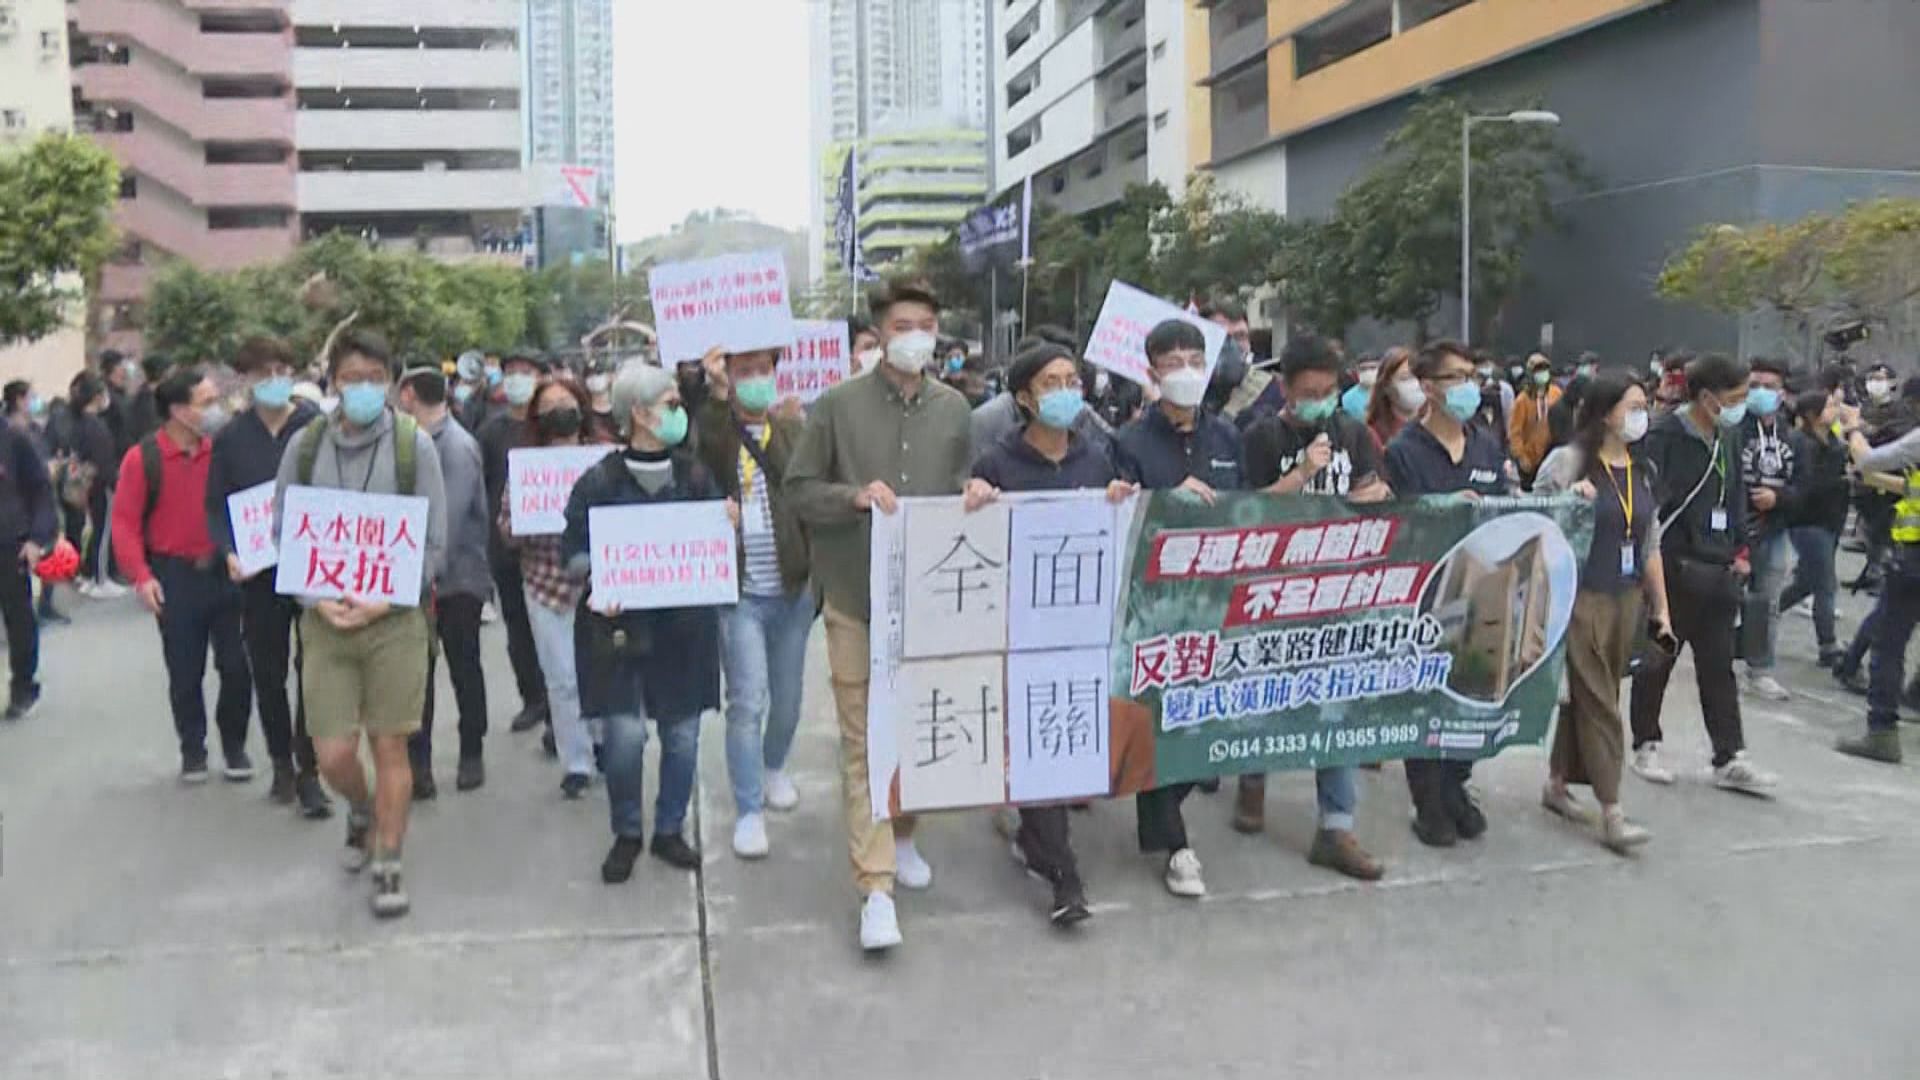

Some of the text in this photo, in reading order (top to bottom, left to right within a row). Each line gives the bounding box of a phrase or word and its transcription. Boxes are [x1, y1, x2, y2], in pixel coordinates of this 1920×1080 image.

[293, 507, 417, 550] 天水圍人
[305, 545, 395, 596] 反抗
[1159, 531, 1280, 575] 零通知
[1244, 565, 1420, 619] 不全面封關
[1165, 653, 1450, 722] 變武漢肺炎指定診所
[1335, 727, 1377, 749] 9365
[1379, 724, 1419, 745] 9989
